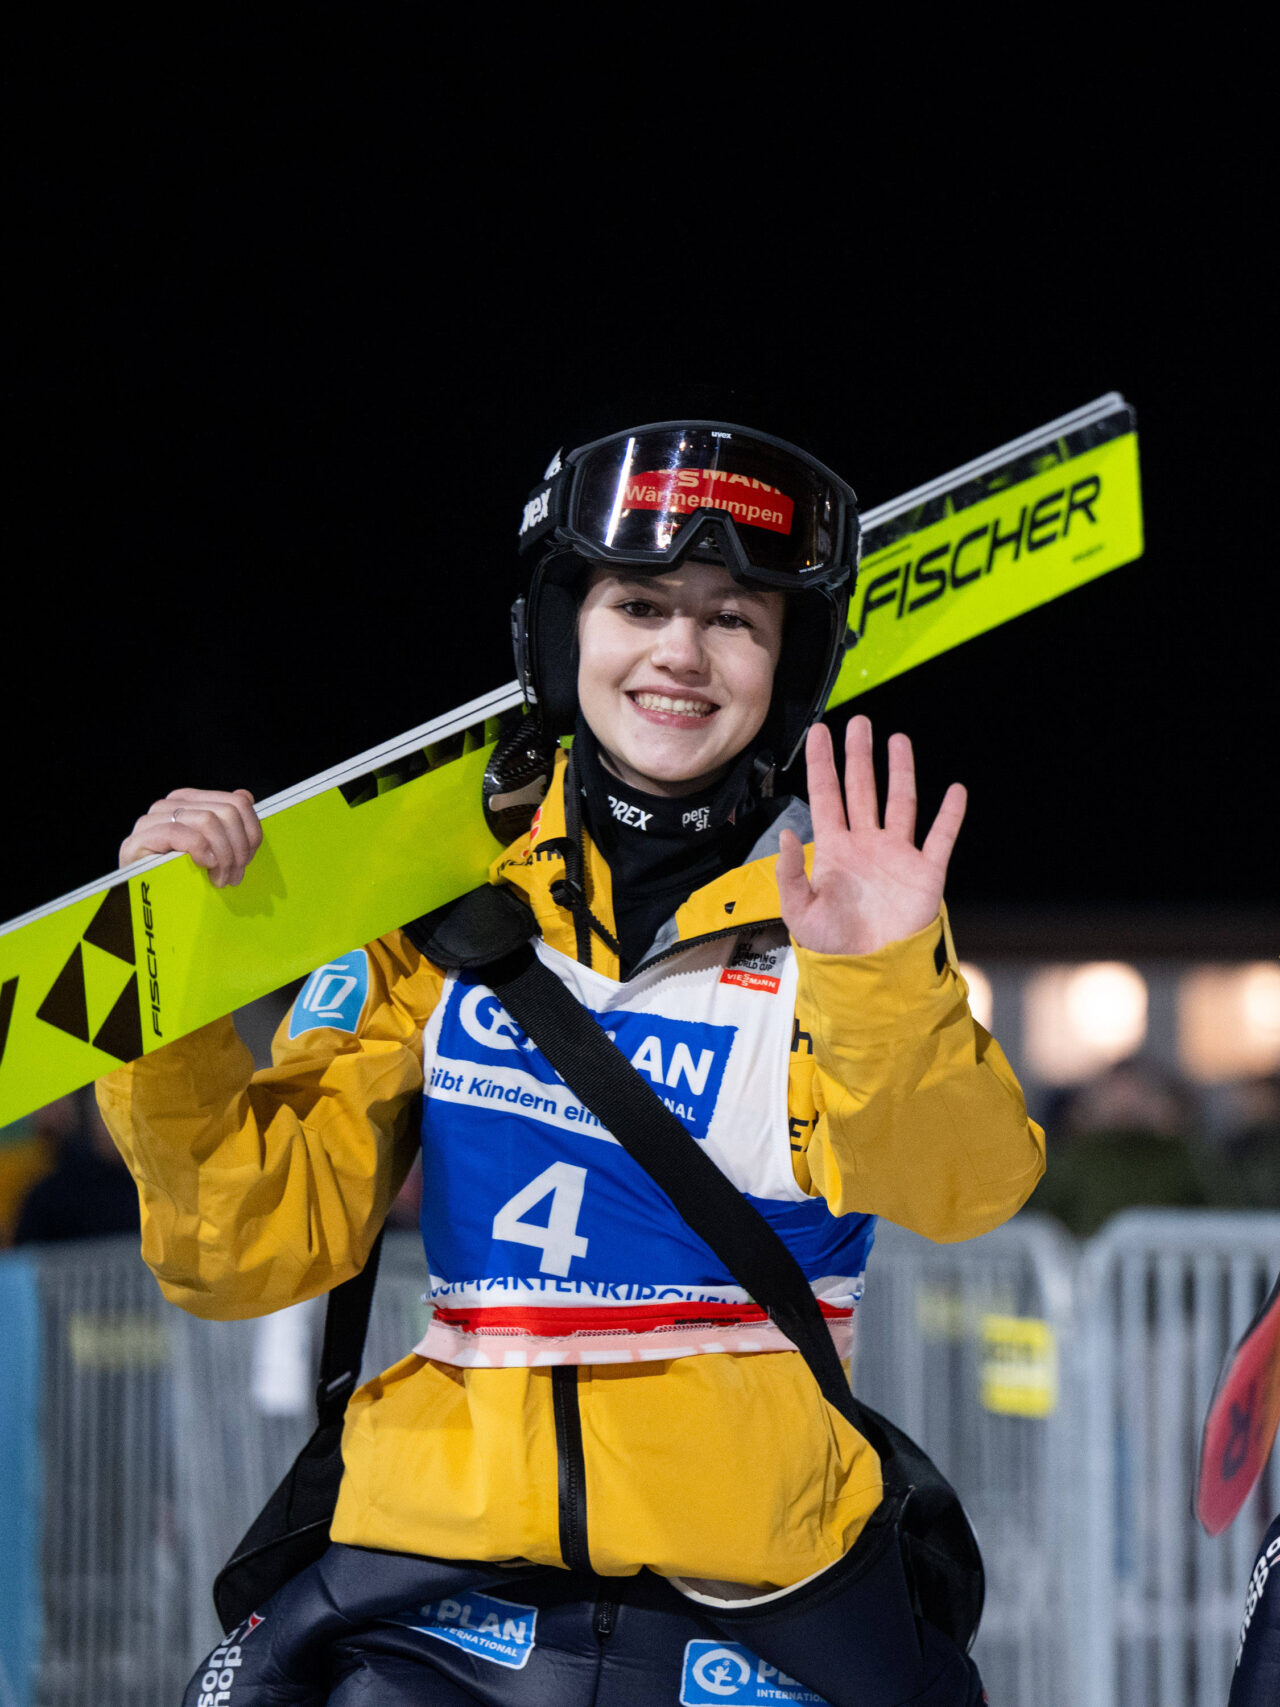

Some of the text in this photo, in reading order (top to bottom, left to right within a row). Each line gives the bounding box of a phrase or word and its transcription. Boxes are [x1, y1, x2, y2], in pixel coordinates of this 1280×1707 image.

[711, 431, 732, 439] uvex
[624, 485, 783, 524] Wärmepumpen
[857, 474, 1102, 639] FISCHER
[141, 881, 163, 1037] FISCHER
[758, 961, 773, 972] CUP
[468, 1076, 557, 1115] Kindern
[492, 1160, 589, 1278] 4
[437, 1599, 526, 1644] PLAN
